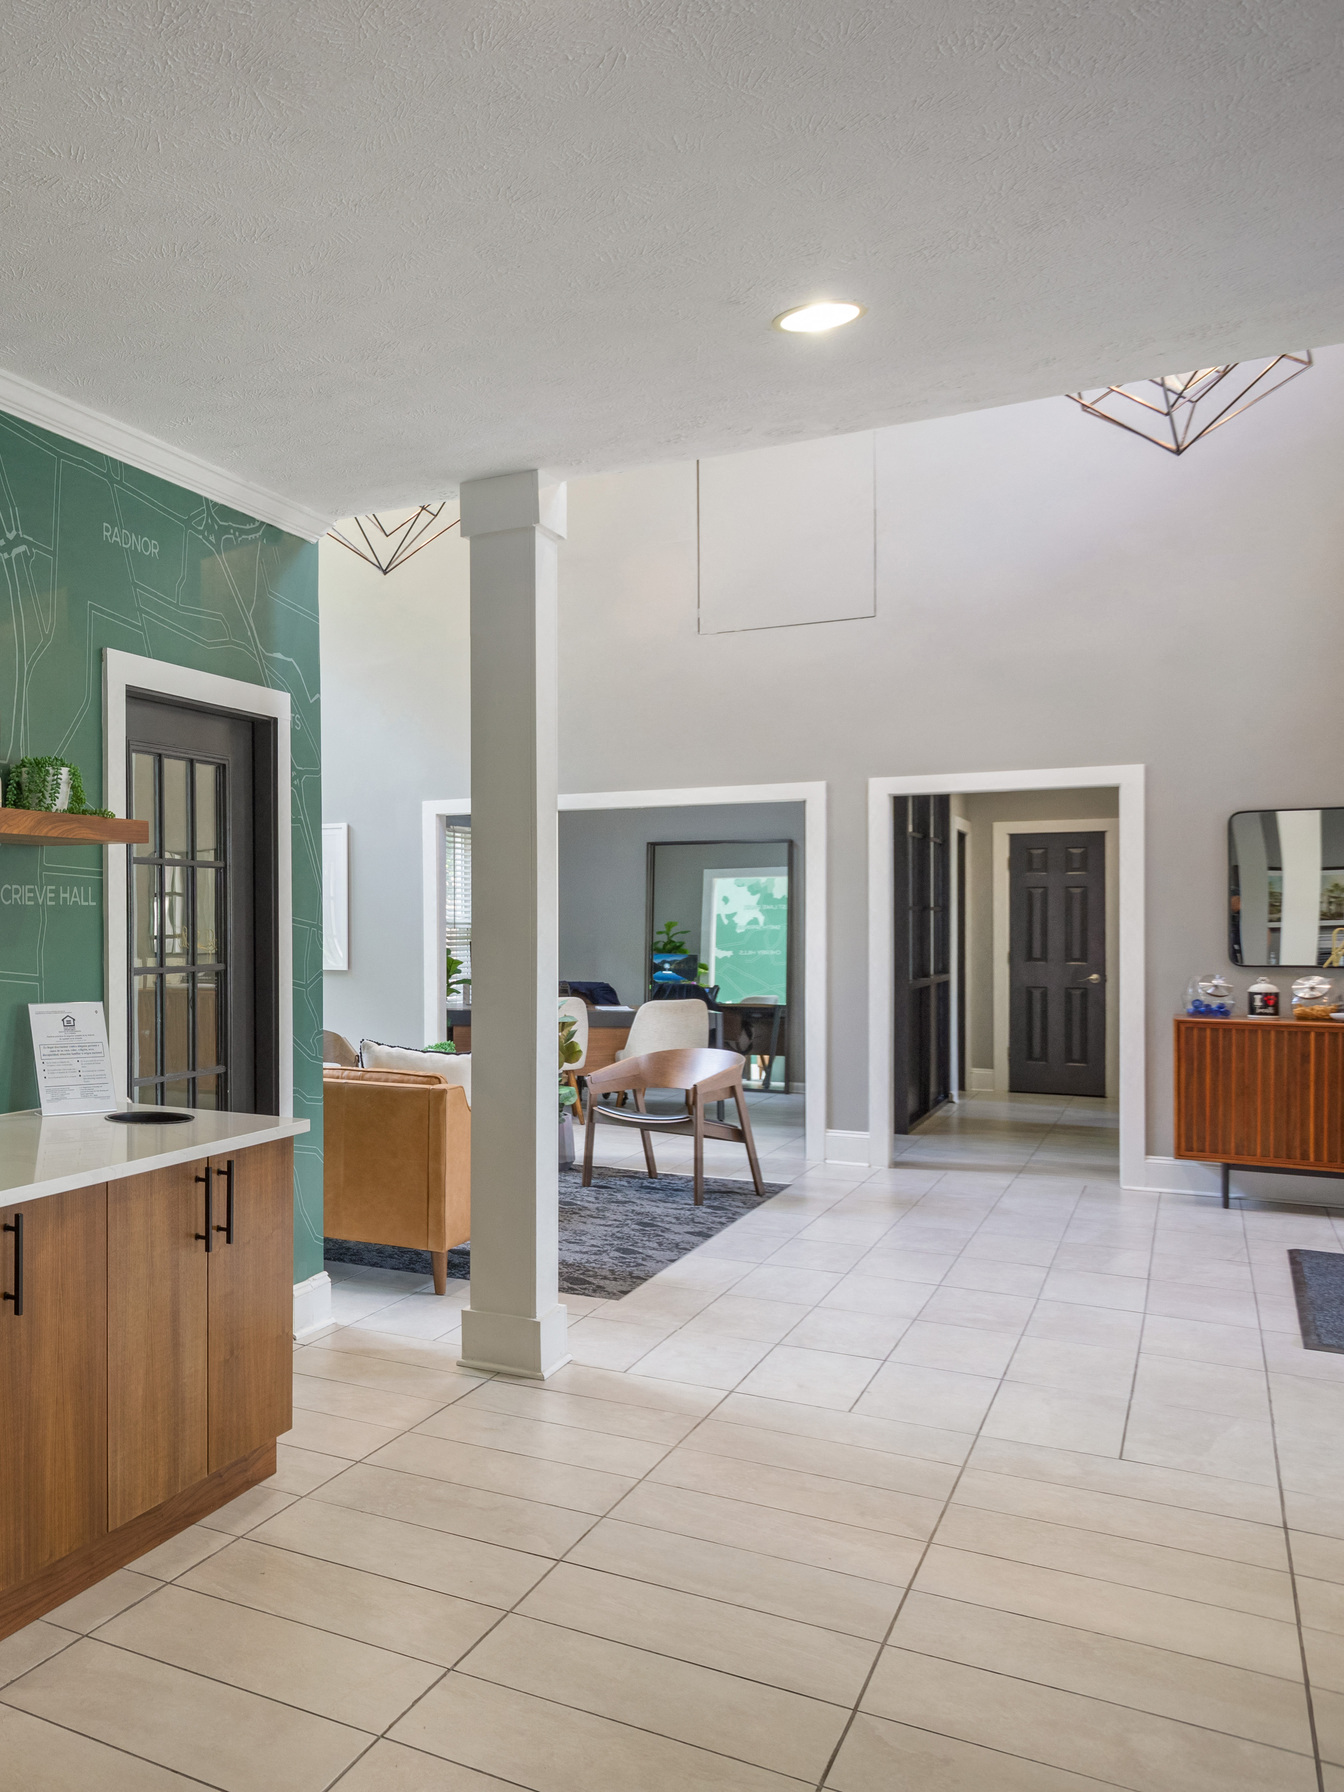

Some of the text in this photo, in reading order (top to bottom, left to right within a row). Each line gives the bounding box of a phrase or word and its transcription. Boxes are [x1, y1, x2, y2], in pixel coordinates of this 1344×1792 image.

[103, 522, 160, 560] RADNOR
[0, 884, 97, 906] CRIEVE HALL
